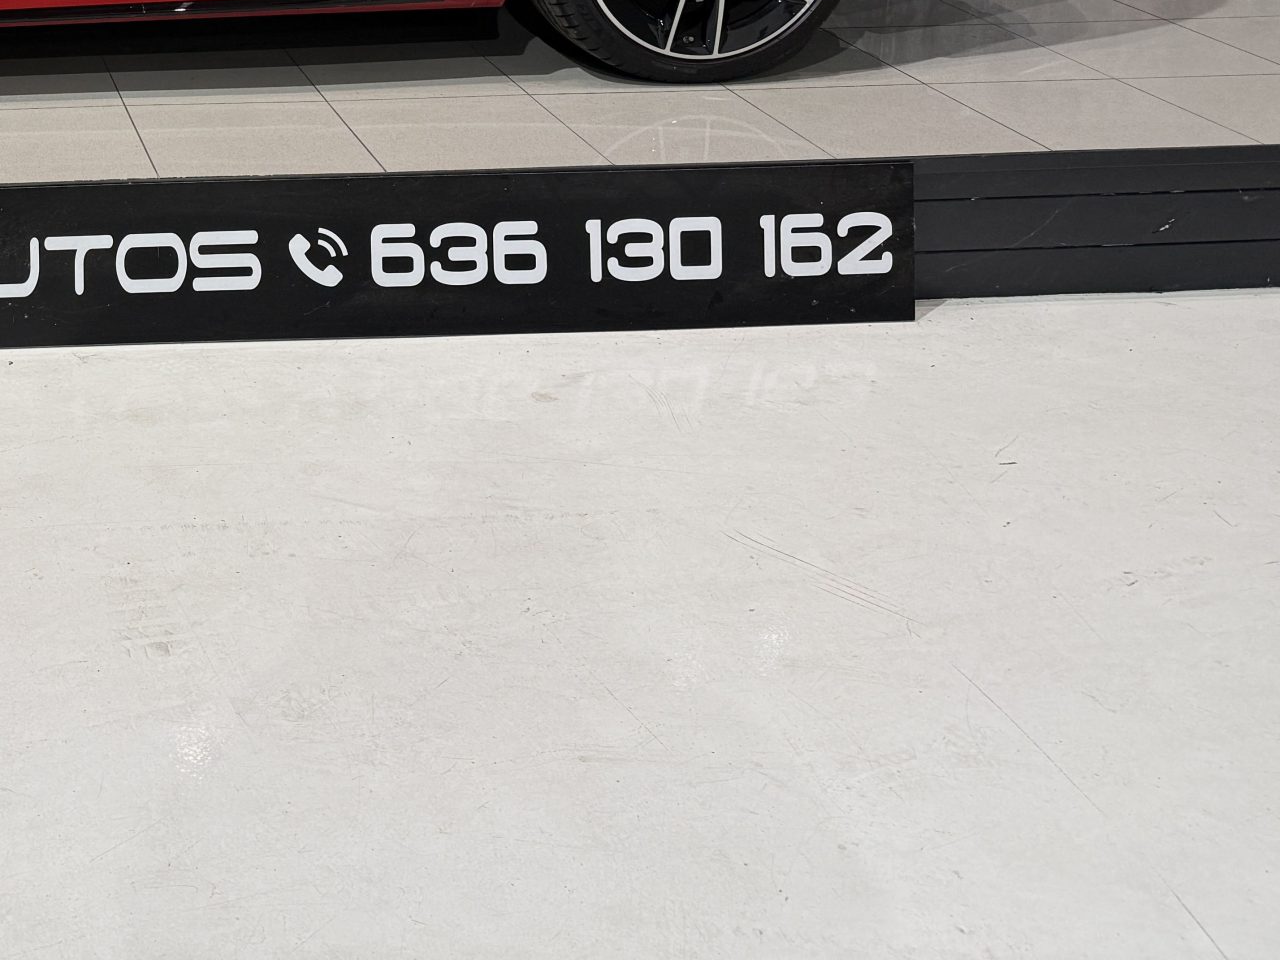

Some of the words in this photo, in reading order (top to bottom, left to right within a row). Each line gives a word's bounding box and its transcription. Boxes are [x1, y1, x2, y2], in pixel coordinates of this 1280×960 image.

[370, 220, 548, 288] 636
[585, 216, 723, 283] 130
[759, 212, 893, 278] 162
